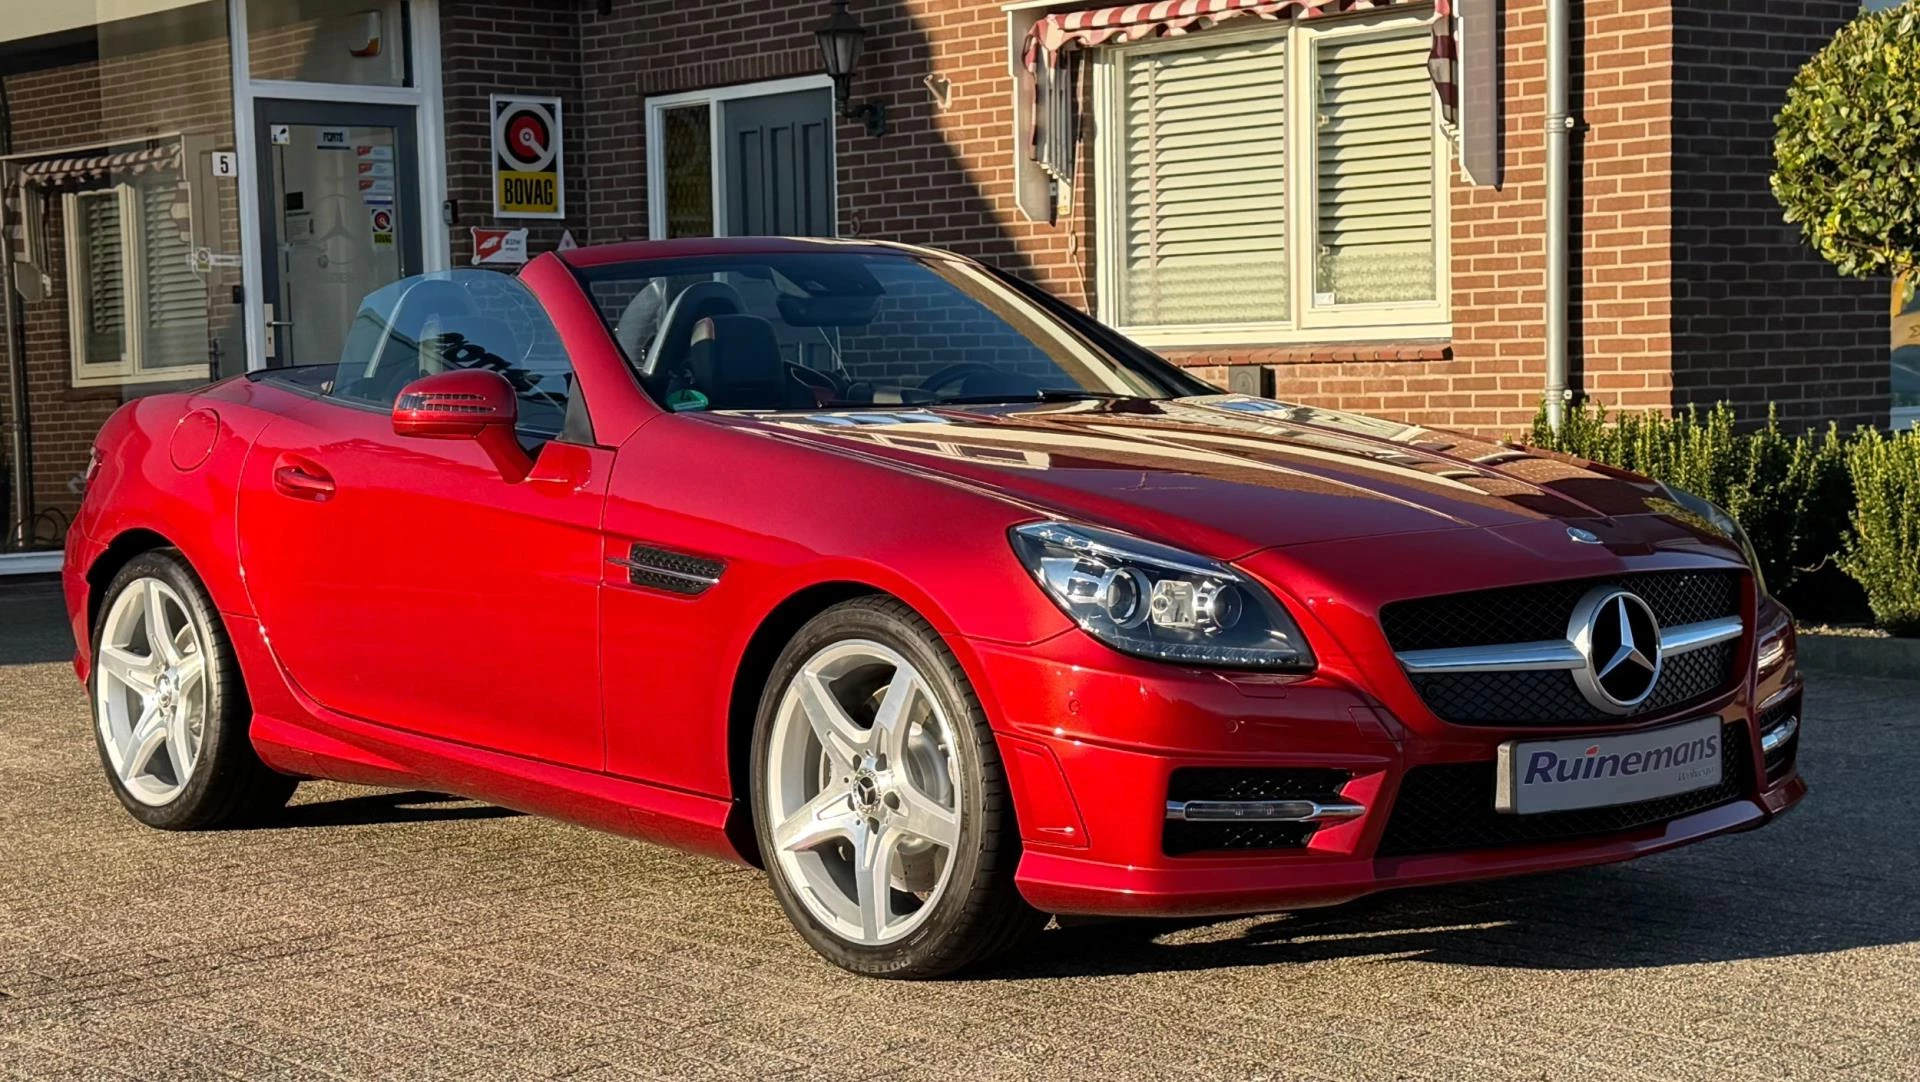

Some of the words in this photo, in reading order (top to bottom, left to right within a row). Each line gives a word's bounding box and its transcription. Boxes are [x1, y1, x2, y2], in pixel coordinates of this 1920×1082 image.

[220, 155, 229, 174] 5
[504, 178, 553, 205] BOVAG
[1523, 734, 1718, 784] Ruinemans
